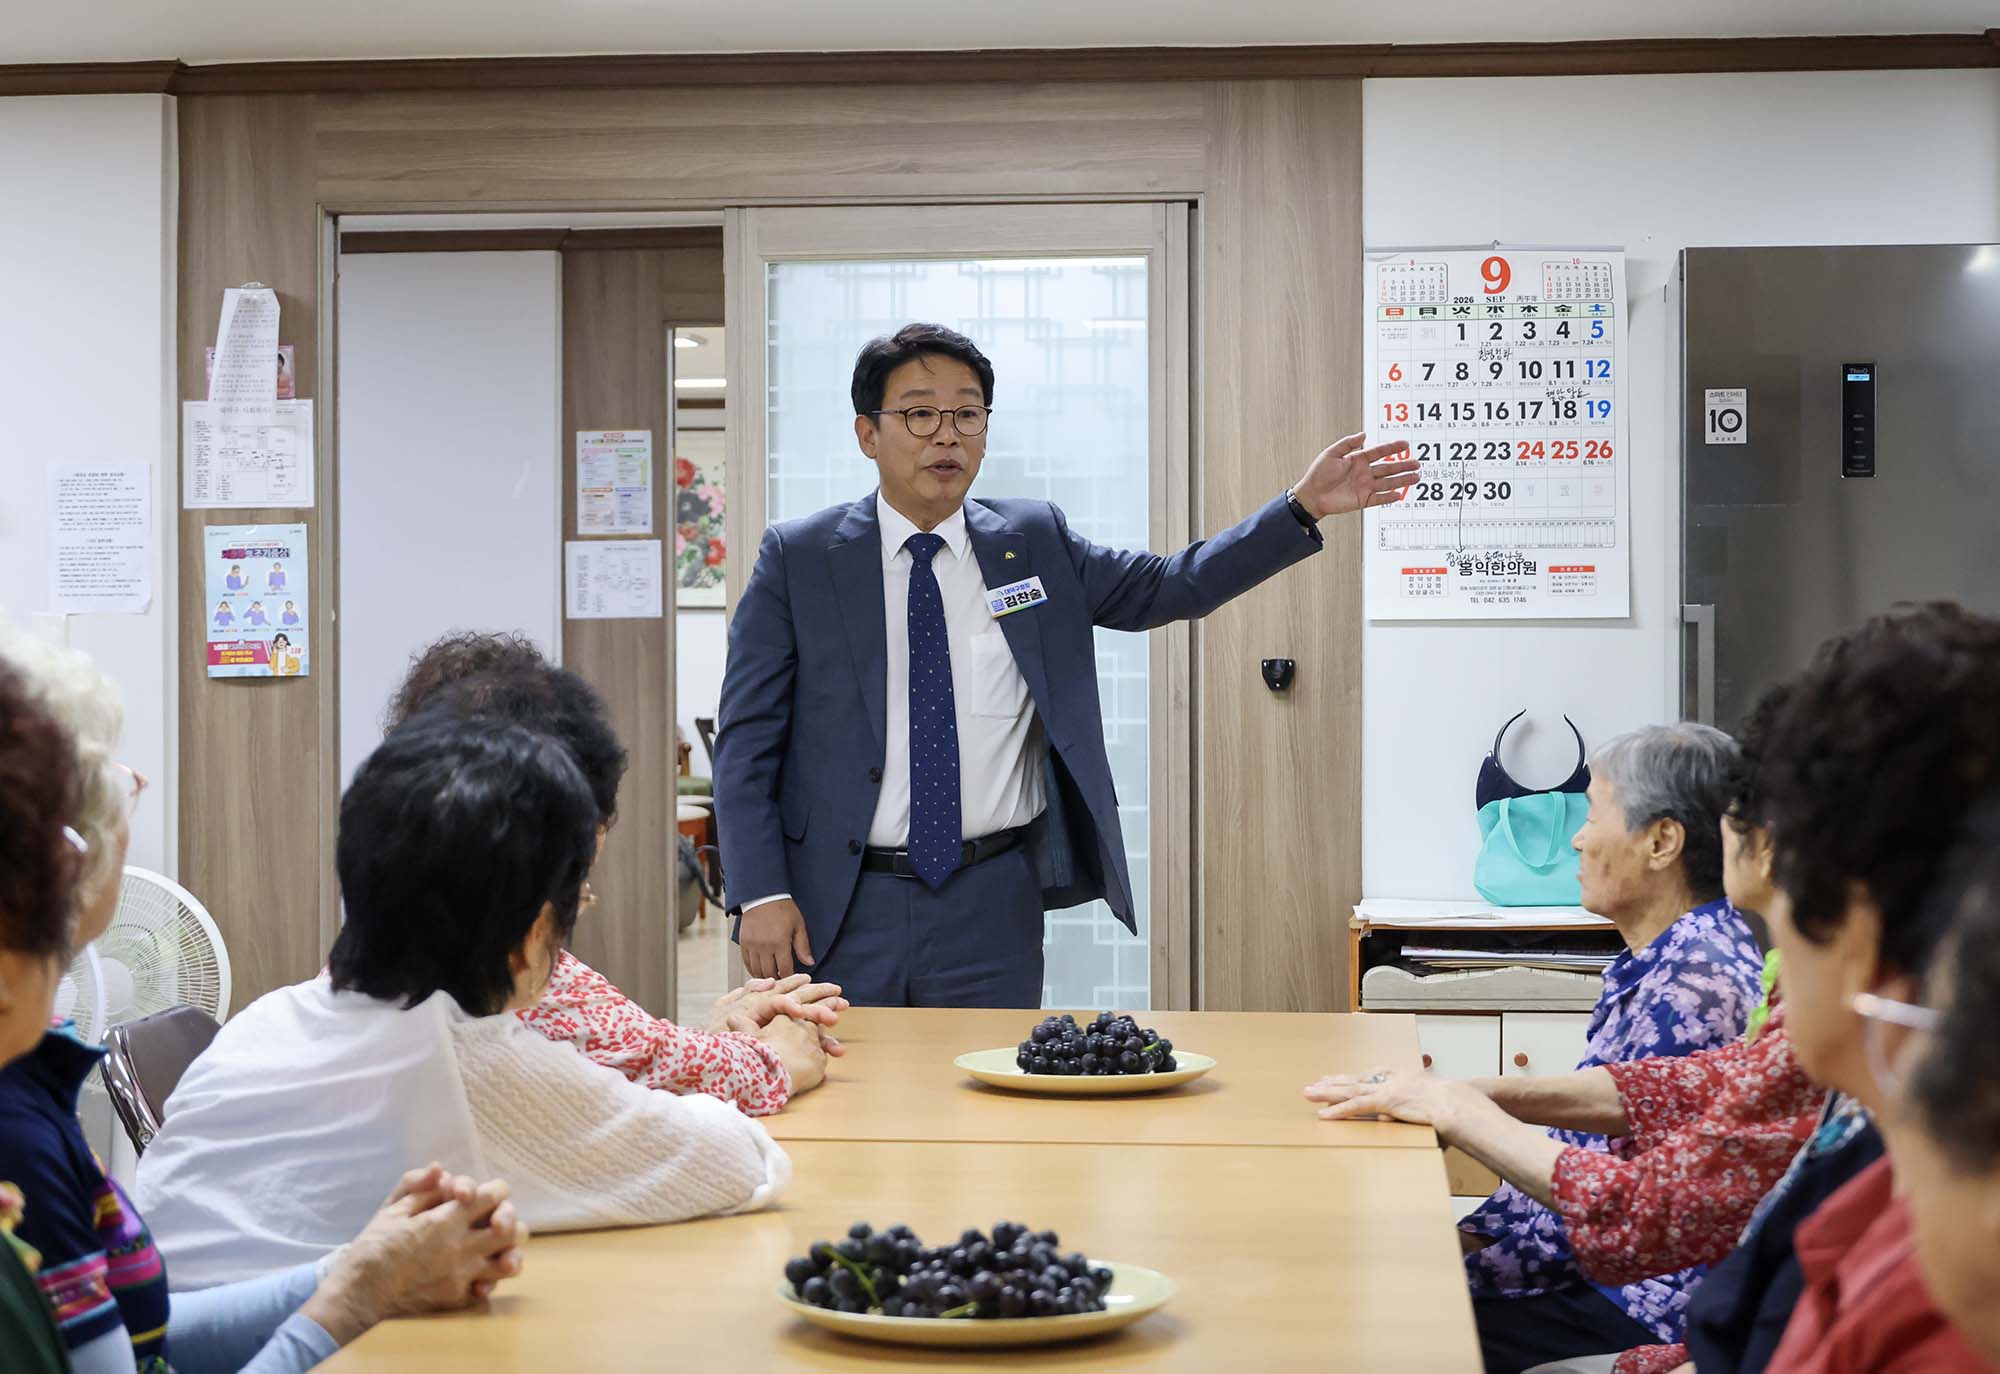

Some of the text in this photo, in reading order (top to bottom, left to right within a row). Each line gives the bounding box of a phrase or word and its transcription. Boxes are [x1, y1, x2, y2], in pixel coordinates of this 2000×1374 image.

[1480, 256, 1511, 294] 9
[1386, 307, 1404, 316] 日
[1419, 307, 1437, 315] 月
[1452, 306, 1471, 315] 火
[1588, 304, 1606, 312] 土
[1457, 323, 1465, 340] 1
[1490, 322, 1502, 340] 2
[1523, 321, 1536, 339] 3
[1556, 321, 1570, 338] 4
[1591, 320, 1604, 338] 5
[1389, 360, 1610, 381] 6 7 8 9 10 11 12
[1384, 400, 1611, 422] 13 14 15 16 17 18 19
[1710, 408, 1742, 433] 10
[1383, 440, 1613, 461] 0 21 22 23 24 25 26
[1416, 482, 1443, 500] 28
[1450, 482, 1477, 500] 29
[1483, 482, 1511, 500] 30
[1459, 561, 1536, 576] 홍익한의원
[1004, 589, 1042, 608] 김찬술
